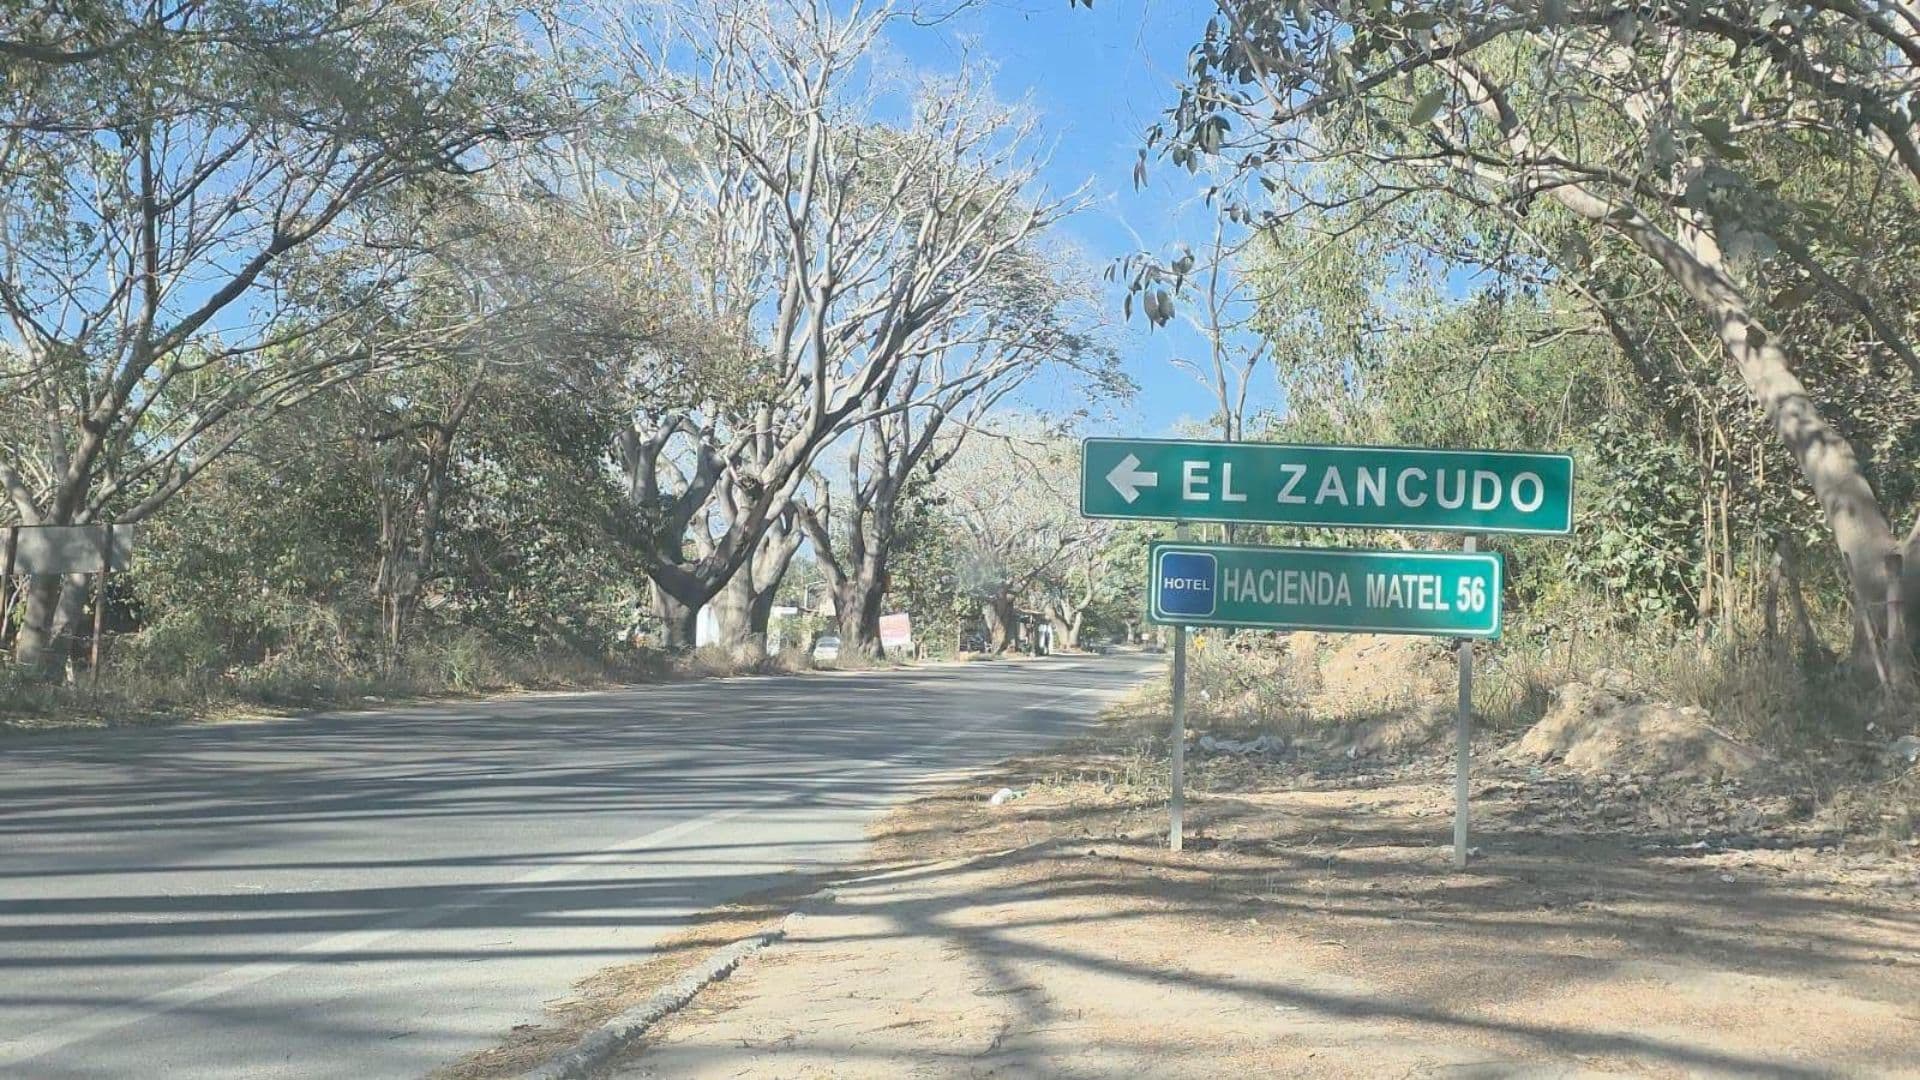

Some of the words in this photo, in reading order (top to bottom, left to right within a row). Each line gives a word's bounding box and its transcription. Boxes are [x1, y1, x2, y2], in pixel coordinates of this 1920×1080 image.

[1182, 461, 1247, 501] EL
[1277, 464, 1544, 512] ZANCUDO
[1163, 577, 1210, 591] HOTEL
[1223, 568, 1352, 607] HACIENDA
[1366, 573, 1449, 611] MATEL
[1456, 576, 1486, 612] 56
